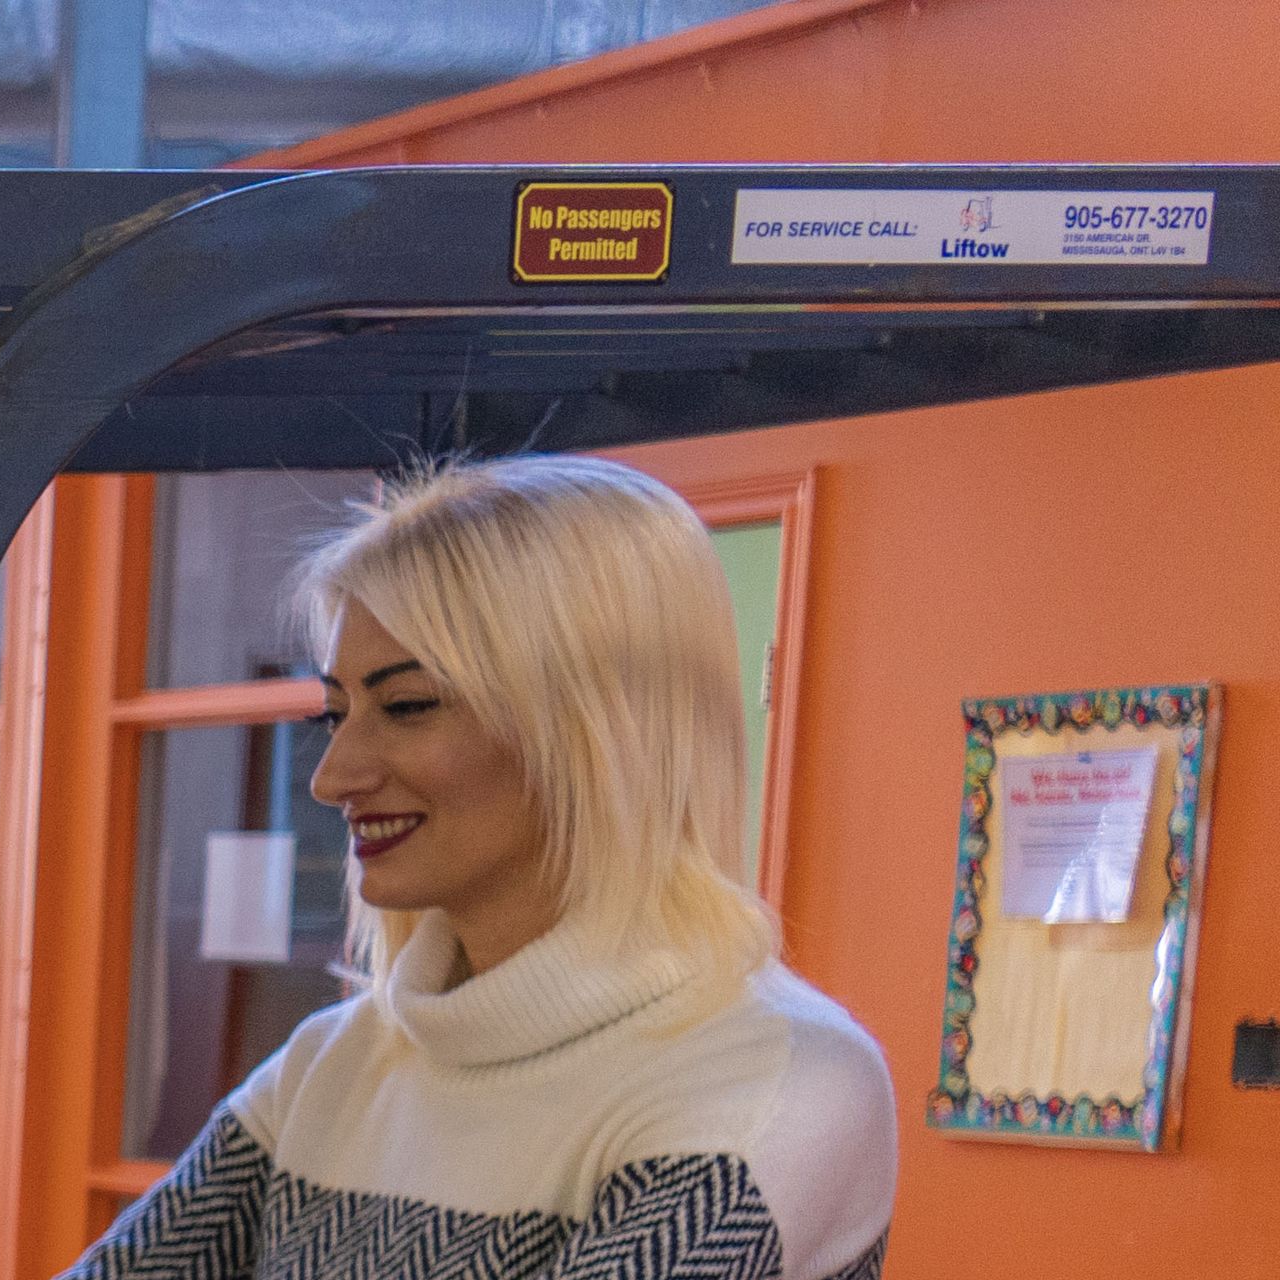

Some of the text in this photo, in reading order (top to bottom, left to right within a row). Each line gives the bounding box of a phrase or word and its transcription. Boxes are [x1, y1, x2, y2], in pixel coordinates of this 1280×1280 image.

[529, 206, 662, 232] No Passengers
[1064, 205, 1208, 229] 905-677-3270
[745, 221, 919, 238] FOR SERVICE CALL:
[1086, 233, 1134, 244] AMERICAN
[548, 237, 638, 261] Permitted
[940, 238, 1009, 259] Liftow
[1062, 245, 1127, 257] MISSISSAUGA,
